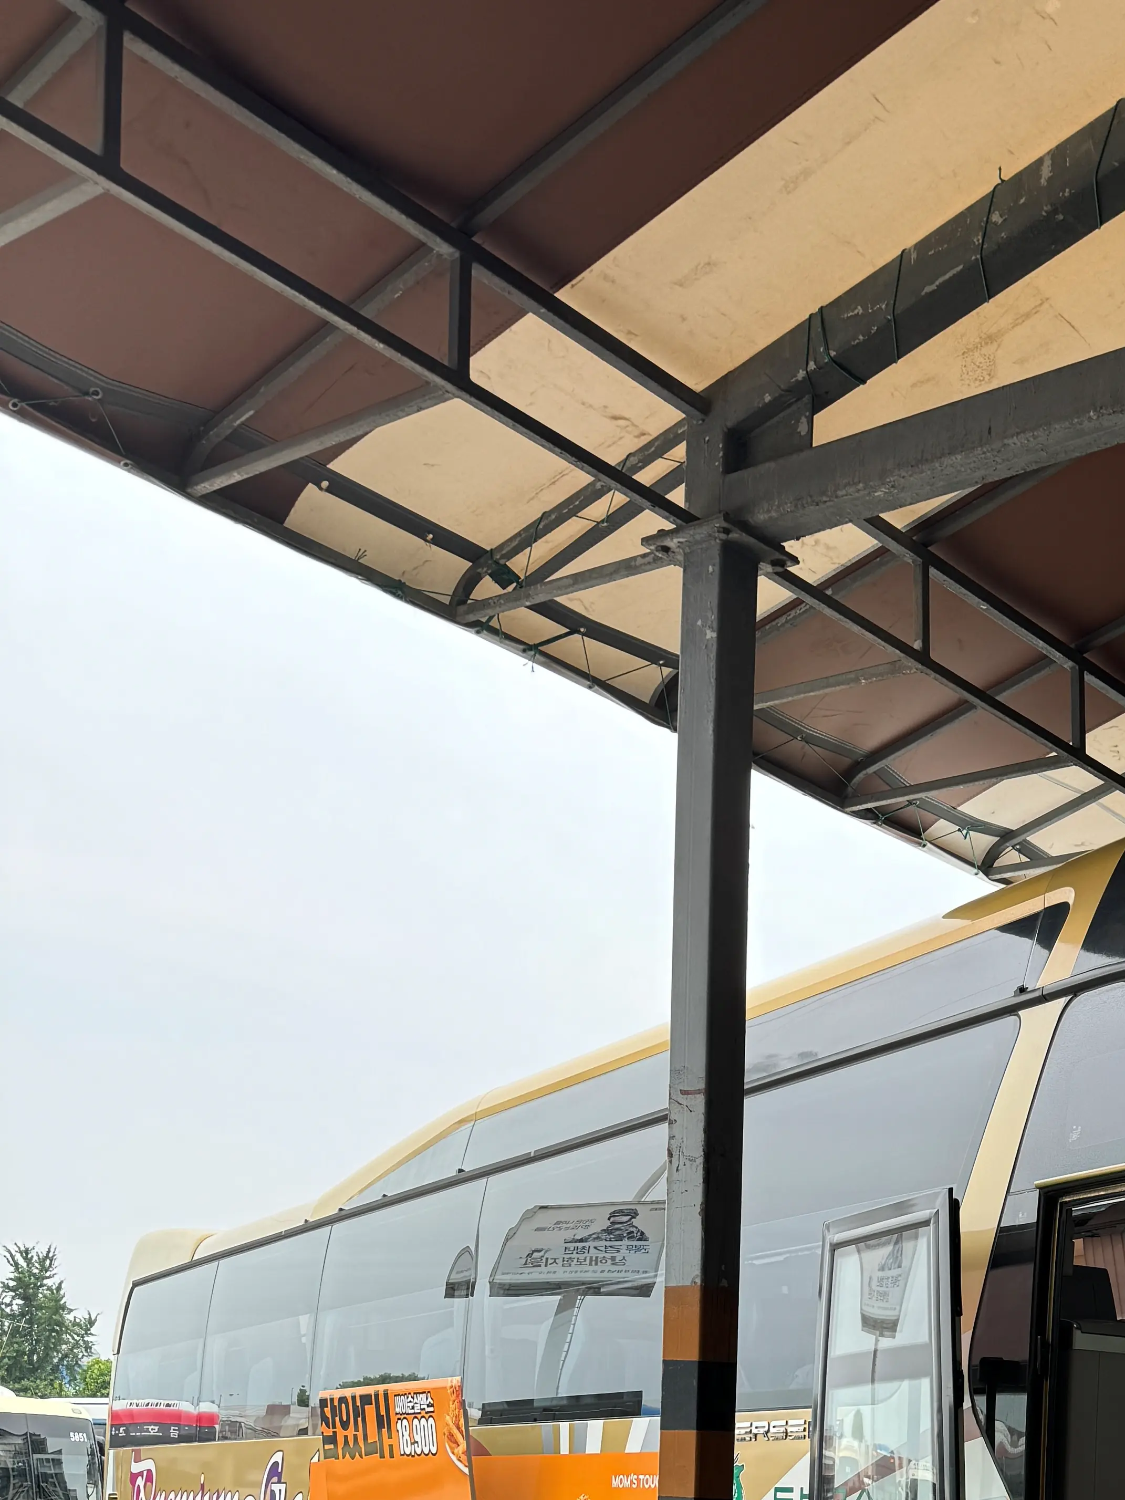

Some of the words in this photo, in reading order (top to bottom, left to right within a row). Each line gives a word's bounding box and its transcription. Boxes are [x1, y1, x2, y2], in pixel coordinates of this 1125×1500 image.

[319, 1389, 395, 1460] 잡았다!
[735, 1419, 807, 1441] ERSE
[69, 1431, 88, 1442] 5851
[611, 1472, 638, 1489] MOM'S
